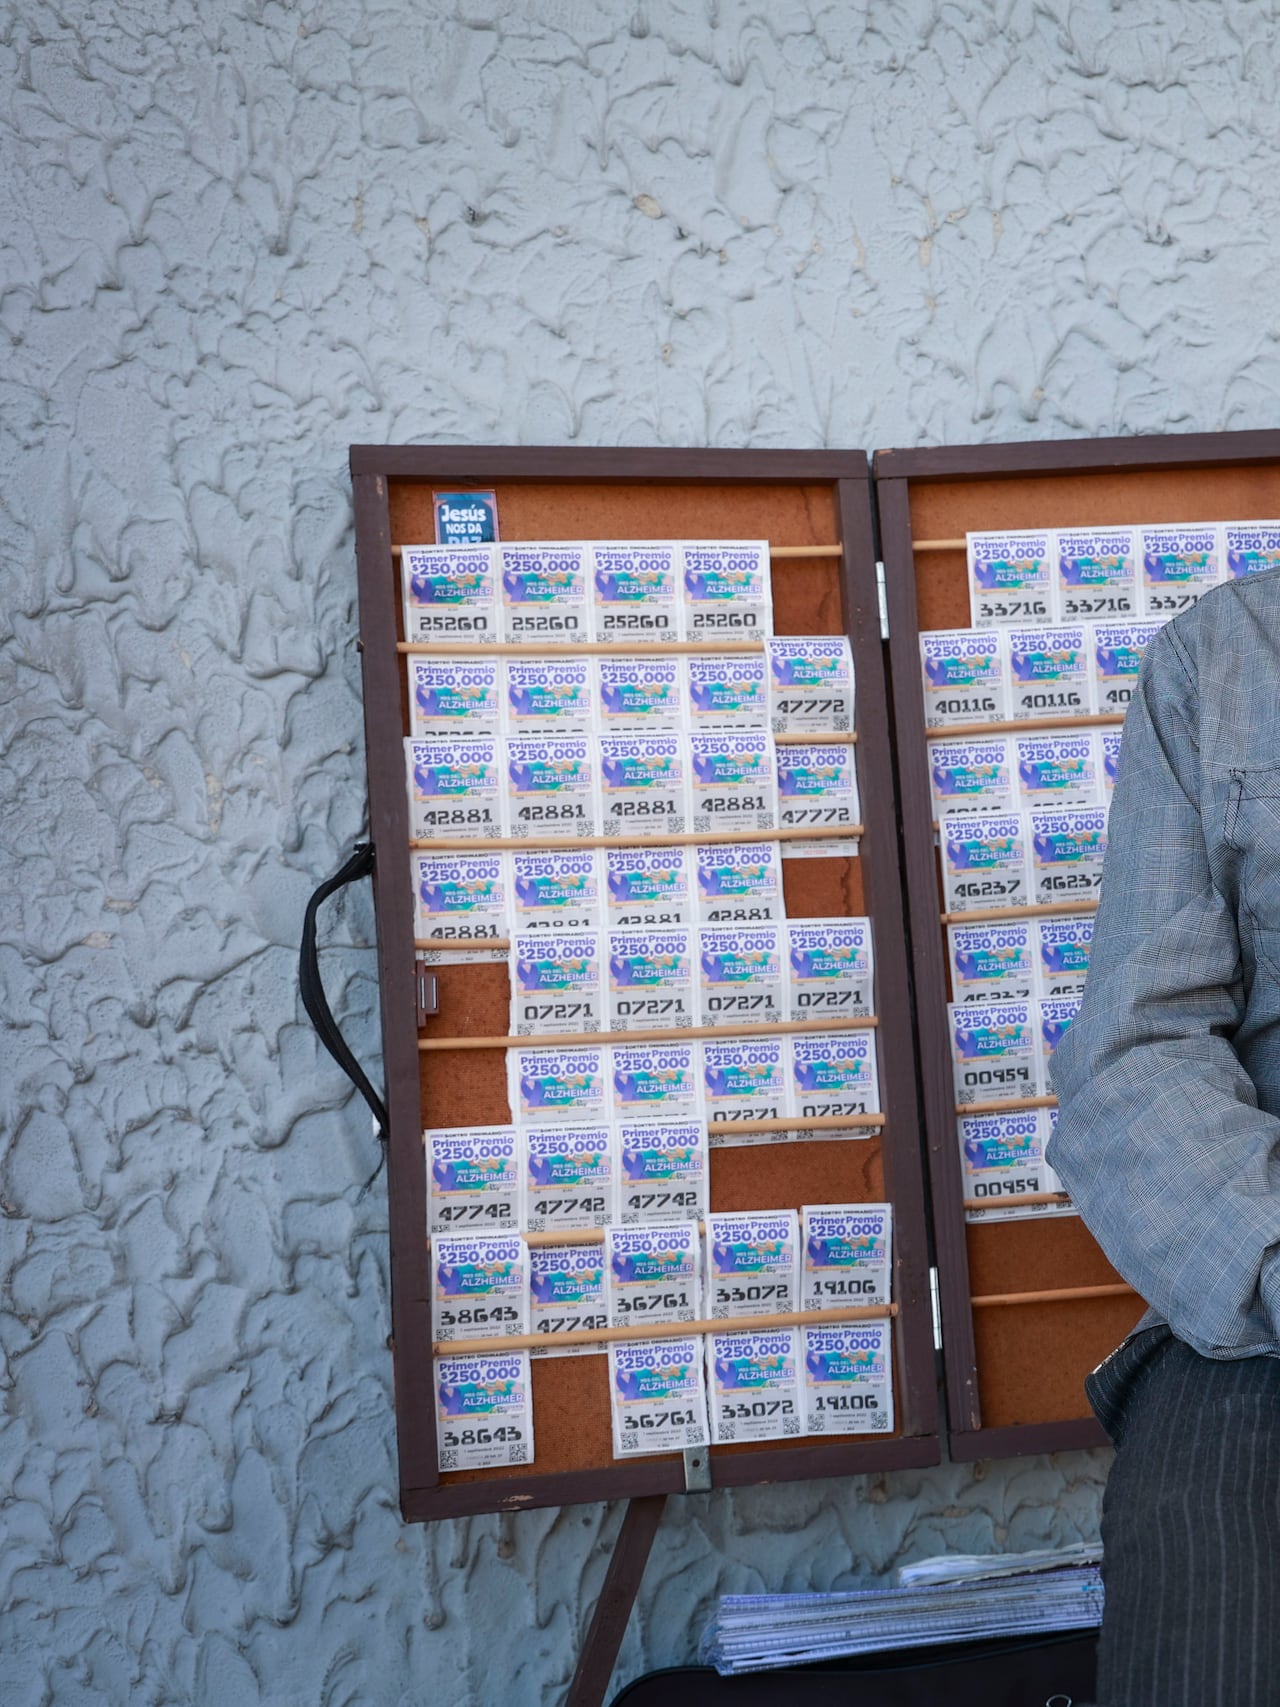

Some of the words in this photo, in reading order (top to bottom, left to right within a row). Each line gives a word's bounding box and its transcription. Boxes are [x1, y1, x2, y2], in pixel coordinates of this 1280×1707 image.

[441, 504, 487, 522] Jesús
[446, 523, 467, 534] NOS
[468, 523, 482, 534] DA
[974, 541, 1008, 549] Primer
[1010, 540, 1046, 548] Premio
[1059, 538, 1093, 546] Primer
[1095, 536, 1131, 545] Premio
[1145, 541, 1214, 554] $250,000
[503, 552, 540, 560] Primer
[542, 552, 581, 560] Premio
[595, 551, 631, 559] Primer
[685, 551, 720, 559] Primer
[975, 548, 1046, 561] $250,000
[1061, 544, 1130, 558] $250,000
[410, 555, 448, 564] Primer
[450, 553, 490, 562] Premio
[412, 562, 489, 576] $250,000
[505, 561, 580, 573] $250,000
[597, 560, 671, 573] $250,000
[686, 560, 758, 573] $250,000
[1080, 568, 1135, 578] ALZHEIMER
[995, 572, 1050, 581] ALZHEIMER
[433, 587, 494, 598] ALZHEIMER
[525, 586, 584, 594] ALZHEIMER
[617, 585, 675, 594] ALZHEIMER
[706, 585, 762, 593] ALZHEIMER
[981, 602, 1045, 616] 33716
[1067, 598, 1130, 612] 33716
[420, 617, 487, 630] 25260
[513, 617, 578, 630] 25260
[605, 616, 669, 628] 25260
[694, 614, 756, 627] 25260
[1011, 633, 1045, 642] Primer
[1046, 631, 1083, 640] Premio
[926, 644, 997, 658] $250,000
[1012, 639, 1082, 652] $250,000
[772, 648, 843, 659] $250,000
[1032, 662, 1087, 673] ALZHEIMER
[417, 675, 494, 688] $250,000
[510, 674, 586, 687] $250,000
[602, 672, 675, 685] $250,000
[691, 670, 764, 683] $250,000
[778, 700, 844, 710] 47772
[936, 698, 995, 713] 40116
[1022, 693, 1080, 708] 40116
[413, 745, 451, 754] Primer
[453, 744, 494, 752] Premio
[508, 742, 546, 750] Primer
[547, 740, 587, 749] Premio
[693, 742, 766, 755] $250,000
[415, 752, 493, 766] $250,000
[510, 749, 587, 762] $250,000
[603, 746, 677, 759] $250,000
[1020, 747, 1090, 761] $250,000
[934, 753, 1005, 767] $250,000
[437, 777, 499, 787] ALZHEIMER
[532, 773, 592, 783] ALZHEIMER
[611, 801, 676, 815] 42881
[702, 797, 765, 811] 42881
[424, 809, 491, 825] 42881
[519, 805, 585, 820] 42881
[782, 808, 848, 823] 47772
[946, 822, 981, 830] Primer
[982, 818, 1020, 827] Premio
[1035, 819, 1103, 834] $250,000
[947, 826, 1019, 841] $250,000
[699, 854, 772, 867] $250,000
[969, 850, 1024, 861] ALZHEIMER
[516, 863, 593, 877] $250,000
[609, 858, 683, 872] $250,000
[421, 868, 500, 882] $250,000
[955, 880, 1020, 897] 46237
[790, 929, 825, 938] Primer
[827, 928, 864, 936] Premio
[517, 940, 554, 948] Primer
[557, 938, 596, 947] Premio
[702, 940, 776, 953] $250,000
[791, 936, 863, 949] $250,000
[956, 936, 1027, 951] $250,000
[519, 946, 595, 961] $250,000
[612, 943, 686, 957] $250,000
[812, 960, 868, 970] ALZHEIMER
[539, 972, 599, 982] ALZHEIMER
[709, 995, 774, 1010] 07271
[798, 991, 862, 1006] 07271
[525, 1004, 592, 1019] 07271
[618, 999, 684, 1014] 07271
[954, 1009, 989, 1018] Primer
[991, 1005, 1028, 1015] Premio
[955, 1013, 1028, 1029] $250,000
[706, 1052, 779, 1066] $250,000
[795, 1047, 867, 1061] $250,000
[522, 1062, 599, 1077] $250,000
[615, 1057, 690, 1071] $250,000
[965, 1068, 1028, 1085] 00959
[965, 1123, 1037, 1140] $250,000
[433, 1139, 471, 1148] Primer
[474, 1137, 515, 1146] Premio
[530, 1140, 607, 1155] $250,000
[624, 1135, 699, 1150] $250,000
[434, 1145, 513, 1160] $250,000
[456, 1171, 518, 1183] ALZHEIMER
[975, 1179, 1038, 1197] 00959
[535, 1198, 604, 1214] 47742
[629, 1192, 696, 1208] 47742
[439, 1204, 510, 1221] 47742
[809, 1217, 844, 1225] Primer
[846, 1215, 884, 1224] Premio
[714, 1229, 789, 1243] $250,000
[810, 1224, 883, 1238] $250,000
[438, 1243, 477, 1252] Primer
[479, 1240, 521, 1250] Premio
[614, 1238, 690, 1253] $250,000
[440, 1249, 519, 1264] $250,000
[828, 1249, 885, 1259] ALZHEIMER
[461, 1275, 523, 1287] ALZHEIMER
[814, 1280, 875, 1295] 19106
[717, 1285, 787, 1302] 33072
[618, 1293, 688, 1311] 36761
[441, 1307, 518, 1325] 38643
[538, 1315, 607, 1333] 47742
[716, 1343, 791, 1358] $250,000
[808, 1339, 881, 1352] $250,000
[439, 1362, 478, 1372] Primer
[480, 1358, 522, 1369] Premio
[617, 1352, 694, 1369] $250,000
[441, 1367, 520, 1384] $250,000
[462, 1393, 525, 1406] ALZHEIMER
[816, 1395, 878, 1410] 19106
[723, 1400, 792, 1418] 33072
[625, 1410, 696, 1429] 36761
[444, 1427, 521, 1447] 38643
